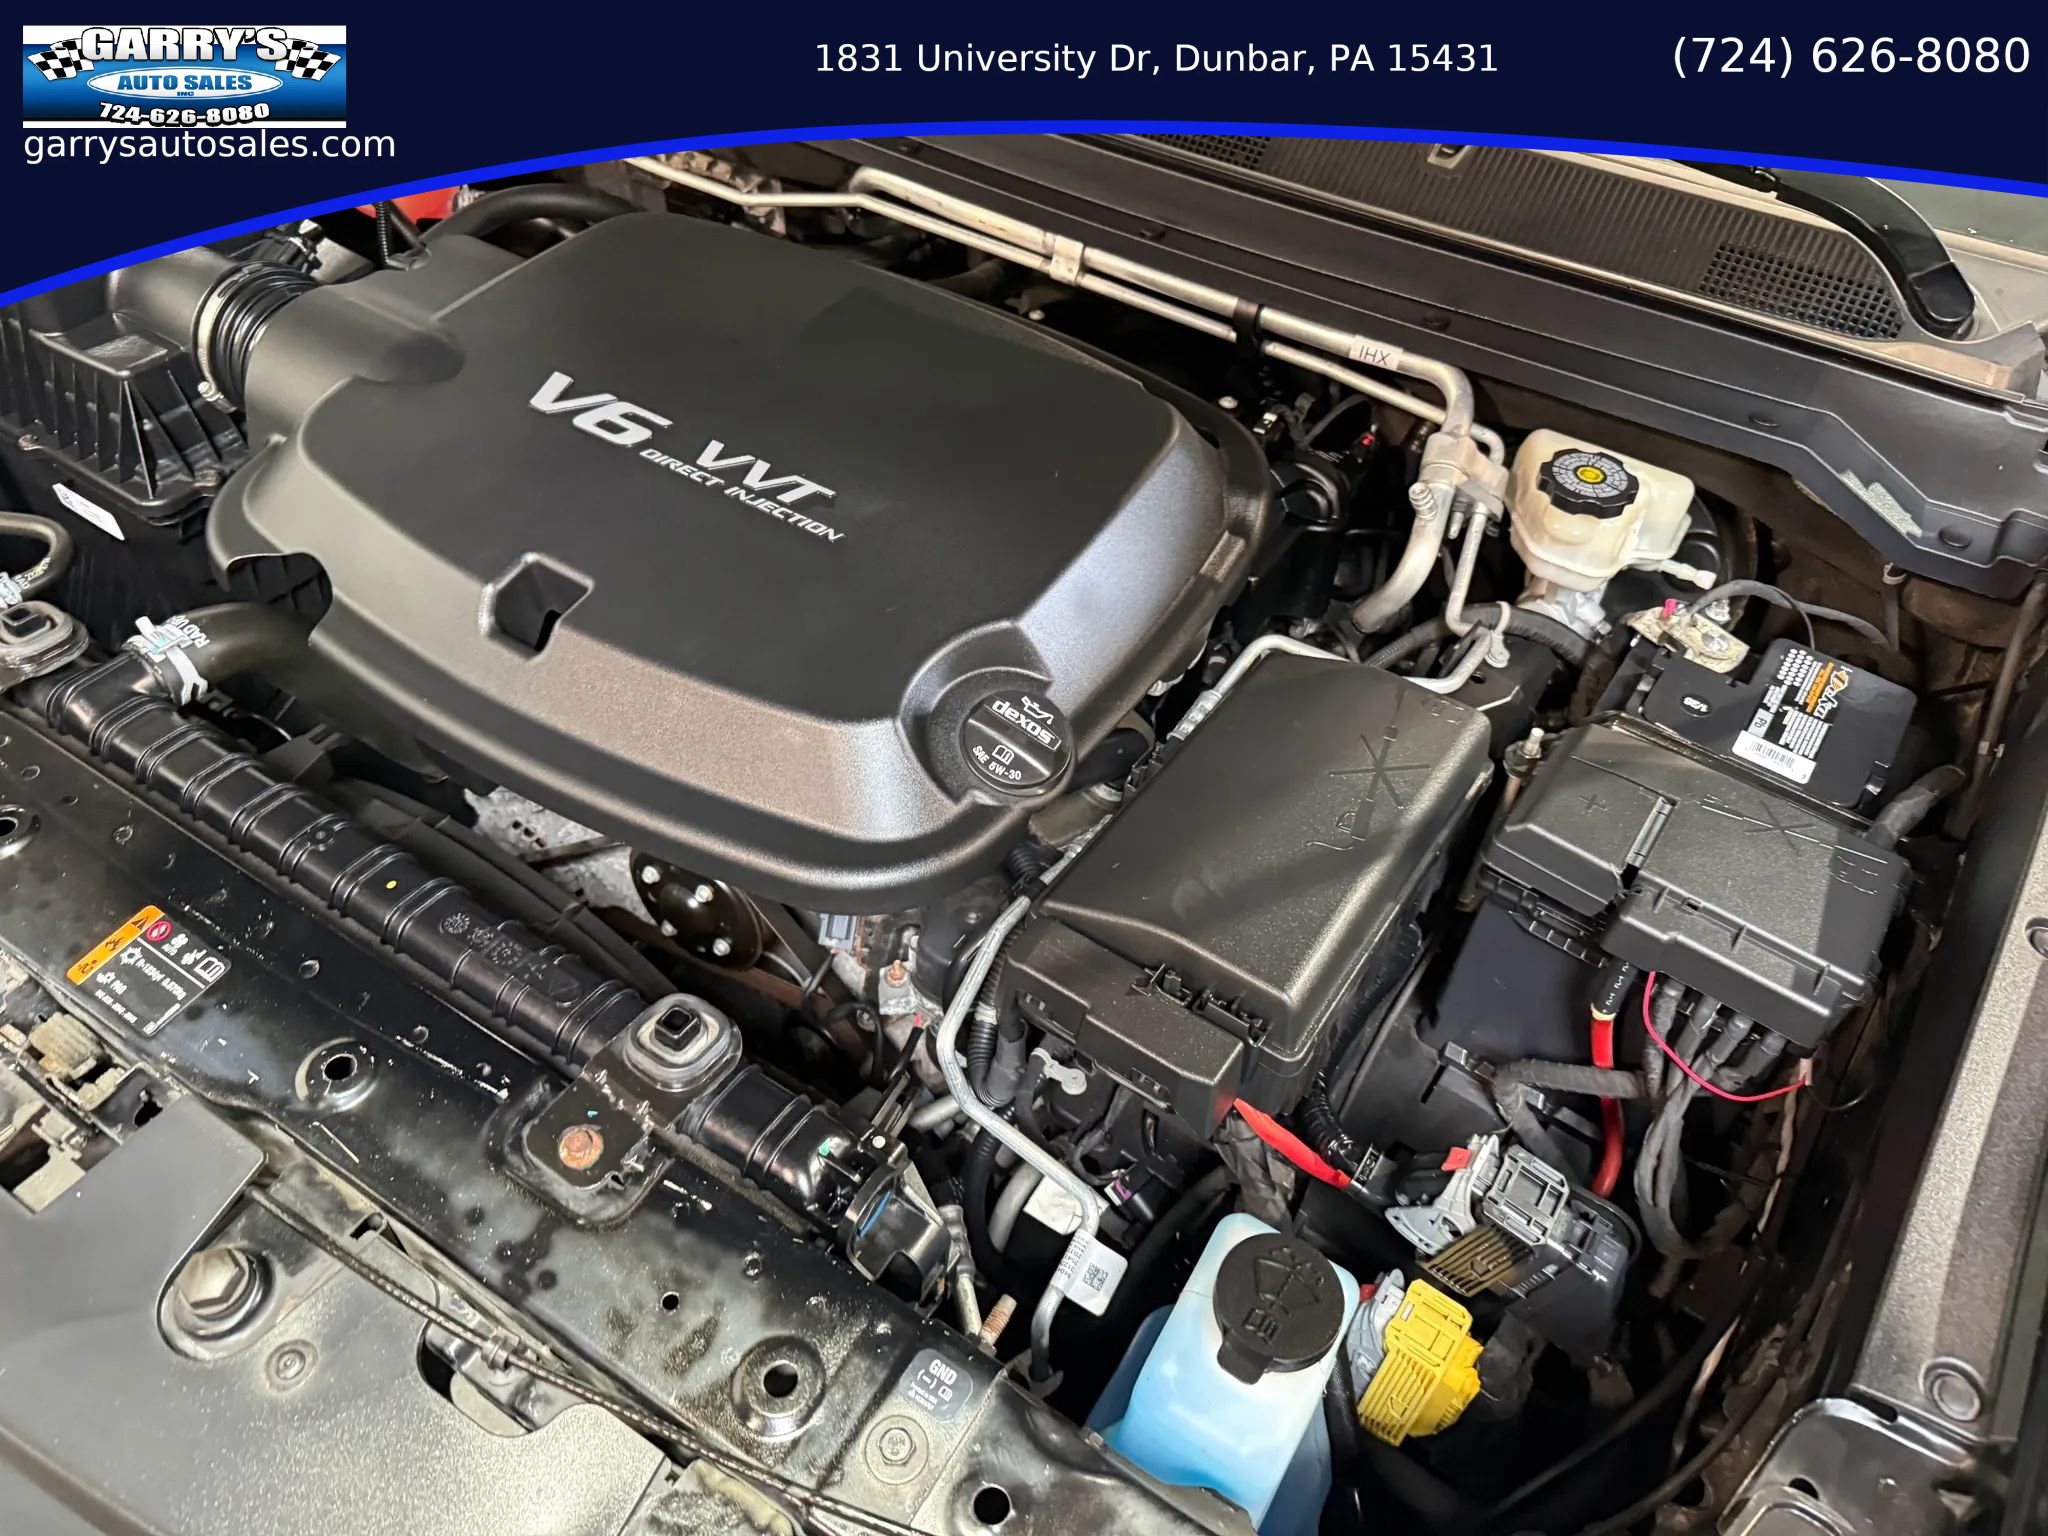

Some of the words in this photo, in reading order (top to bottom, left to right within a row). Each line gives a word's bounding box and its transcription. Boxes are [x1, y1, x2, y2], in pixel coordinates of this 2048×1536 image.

[529, 370, 673, 448] V6
[696, 439, 836, 505] VVT
[639, 448, 726, 487] DIRECT
[724, 485, 846, 542] INJECTION
[182, 624, 211, 649] RAD
[992, 700, 1056, 745] dexos
[1754, 716, 1768, 729] Pb
[972, 745, 990, 764] SAE
[988, 761, 1022, 780] 5W-30
[929, 1359, 958, 1386] GND
